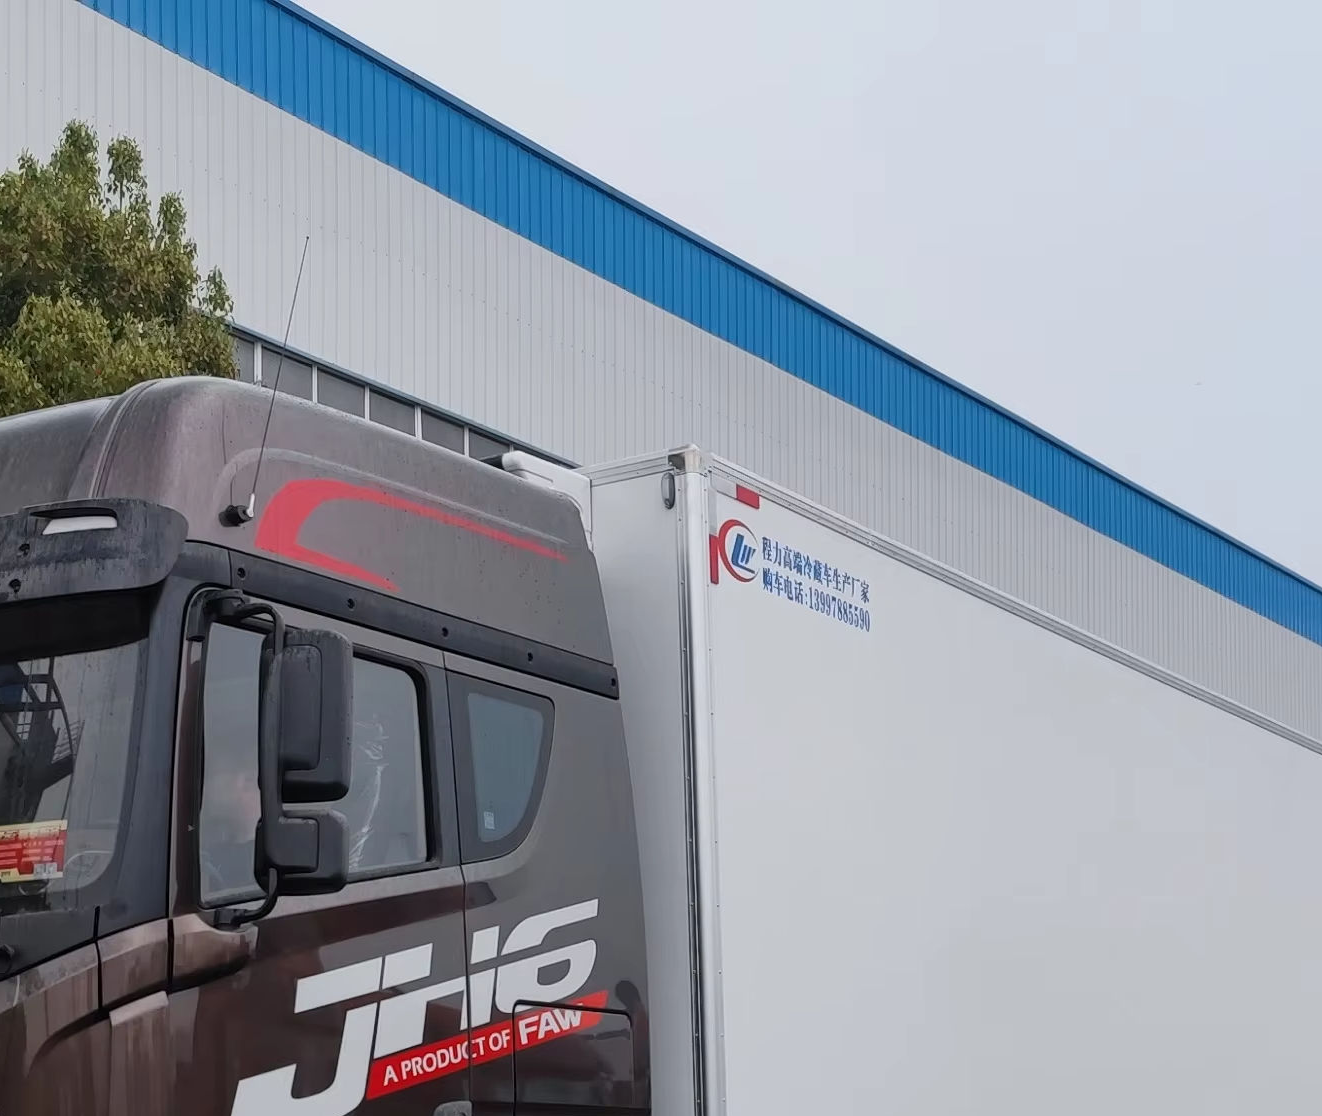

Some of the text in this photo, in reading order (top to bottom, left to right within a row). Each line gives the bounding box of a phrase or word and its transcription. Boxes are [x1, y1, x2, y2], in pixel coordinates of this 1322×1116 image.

[761, 536, 870, 604] 程力高端冷藏车生产厂家
[383, 1003, 584, 1087] A PRODUCT OF FAW
